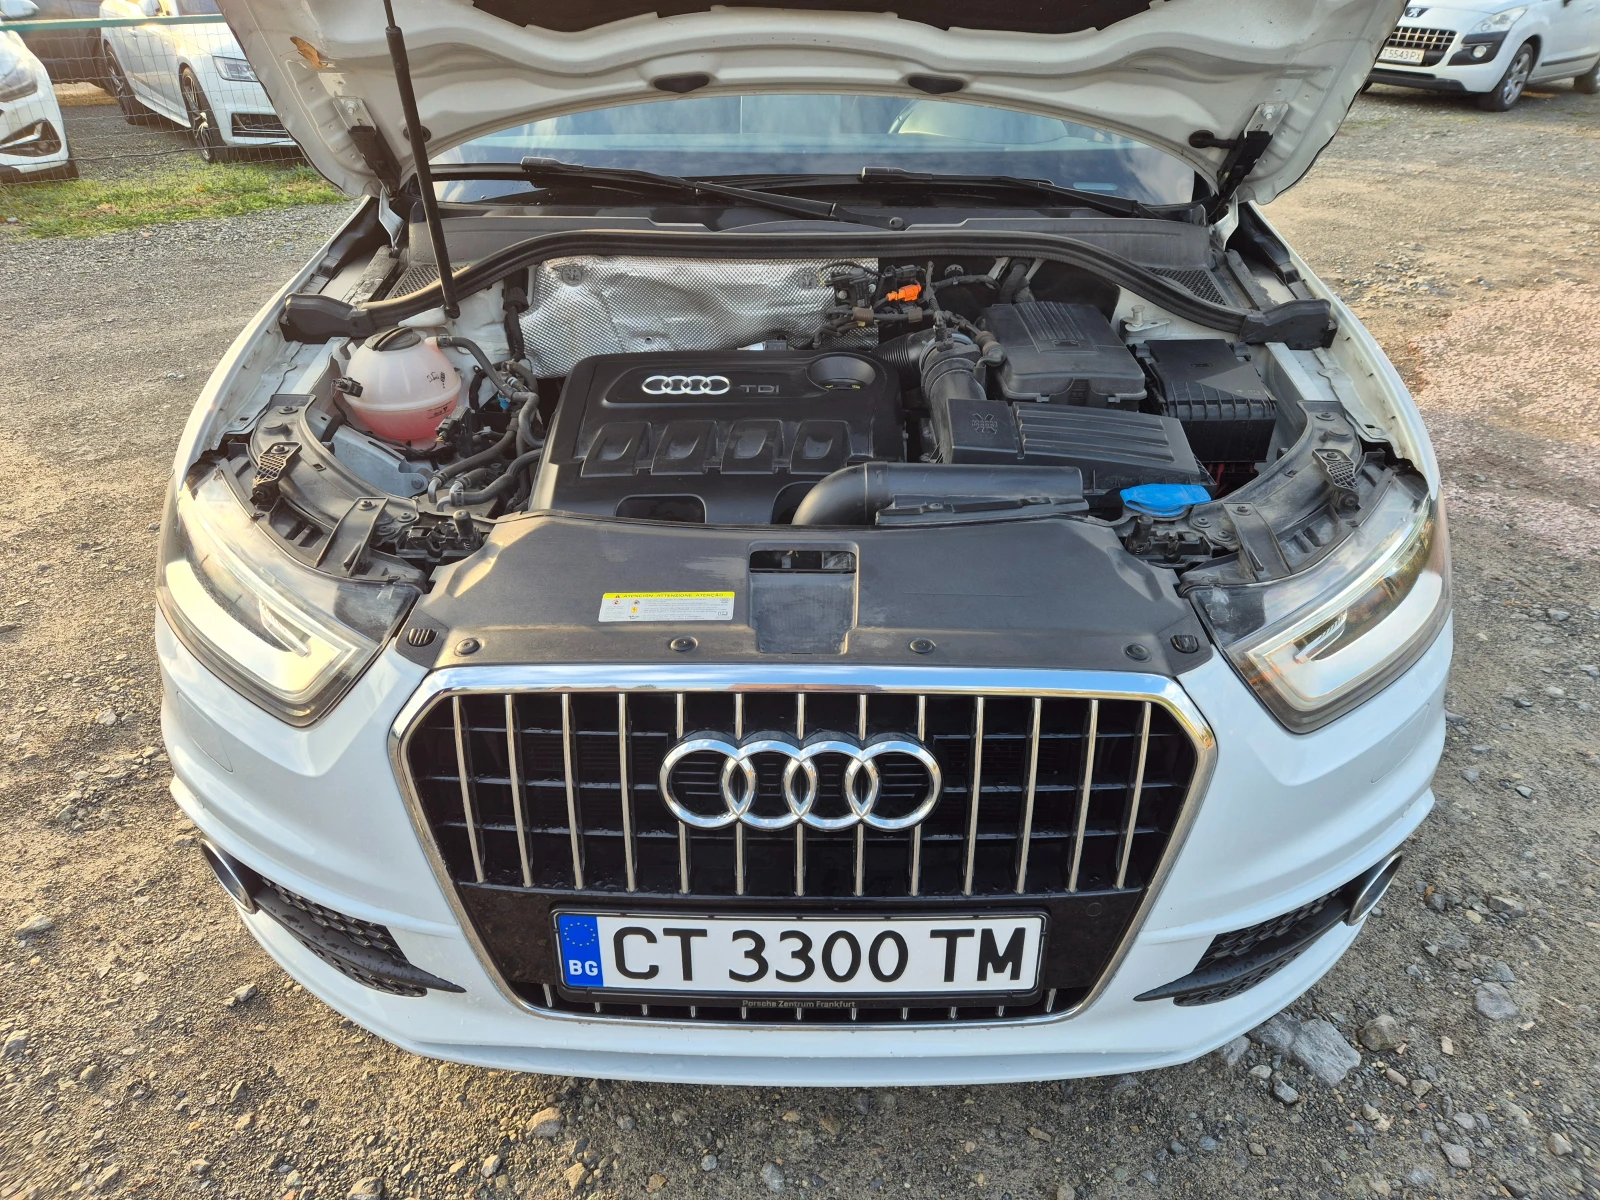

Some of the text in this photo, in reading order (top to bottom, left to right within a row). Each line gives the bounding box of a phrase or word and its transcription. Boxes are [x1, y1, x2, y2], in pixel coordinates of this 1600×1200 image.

[1389, 50, 1409, 60] 5543
[1410, 51, 1422, 61] PX
[740, 384, 780, 393] TDI
[613, 926, 1026, 983] CT 3300 TM
[568, 959, 599, 977] BG
[778, 1000, 815, 1008] Zentrum
